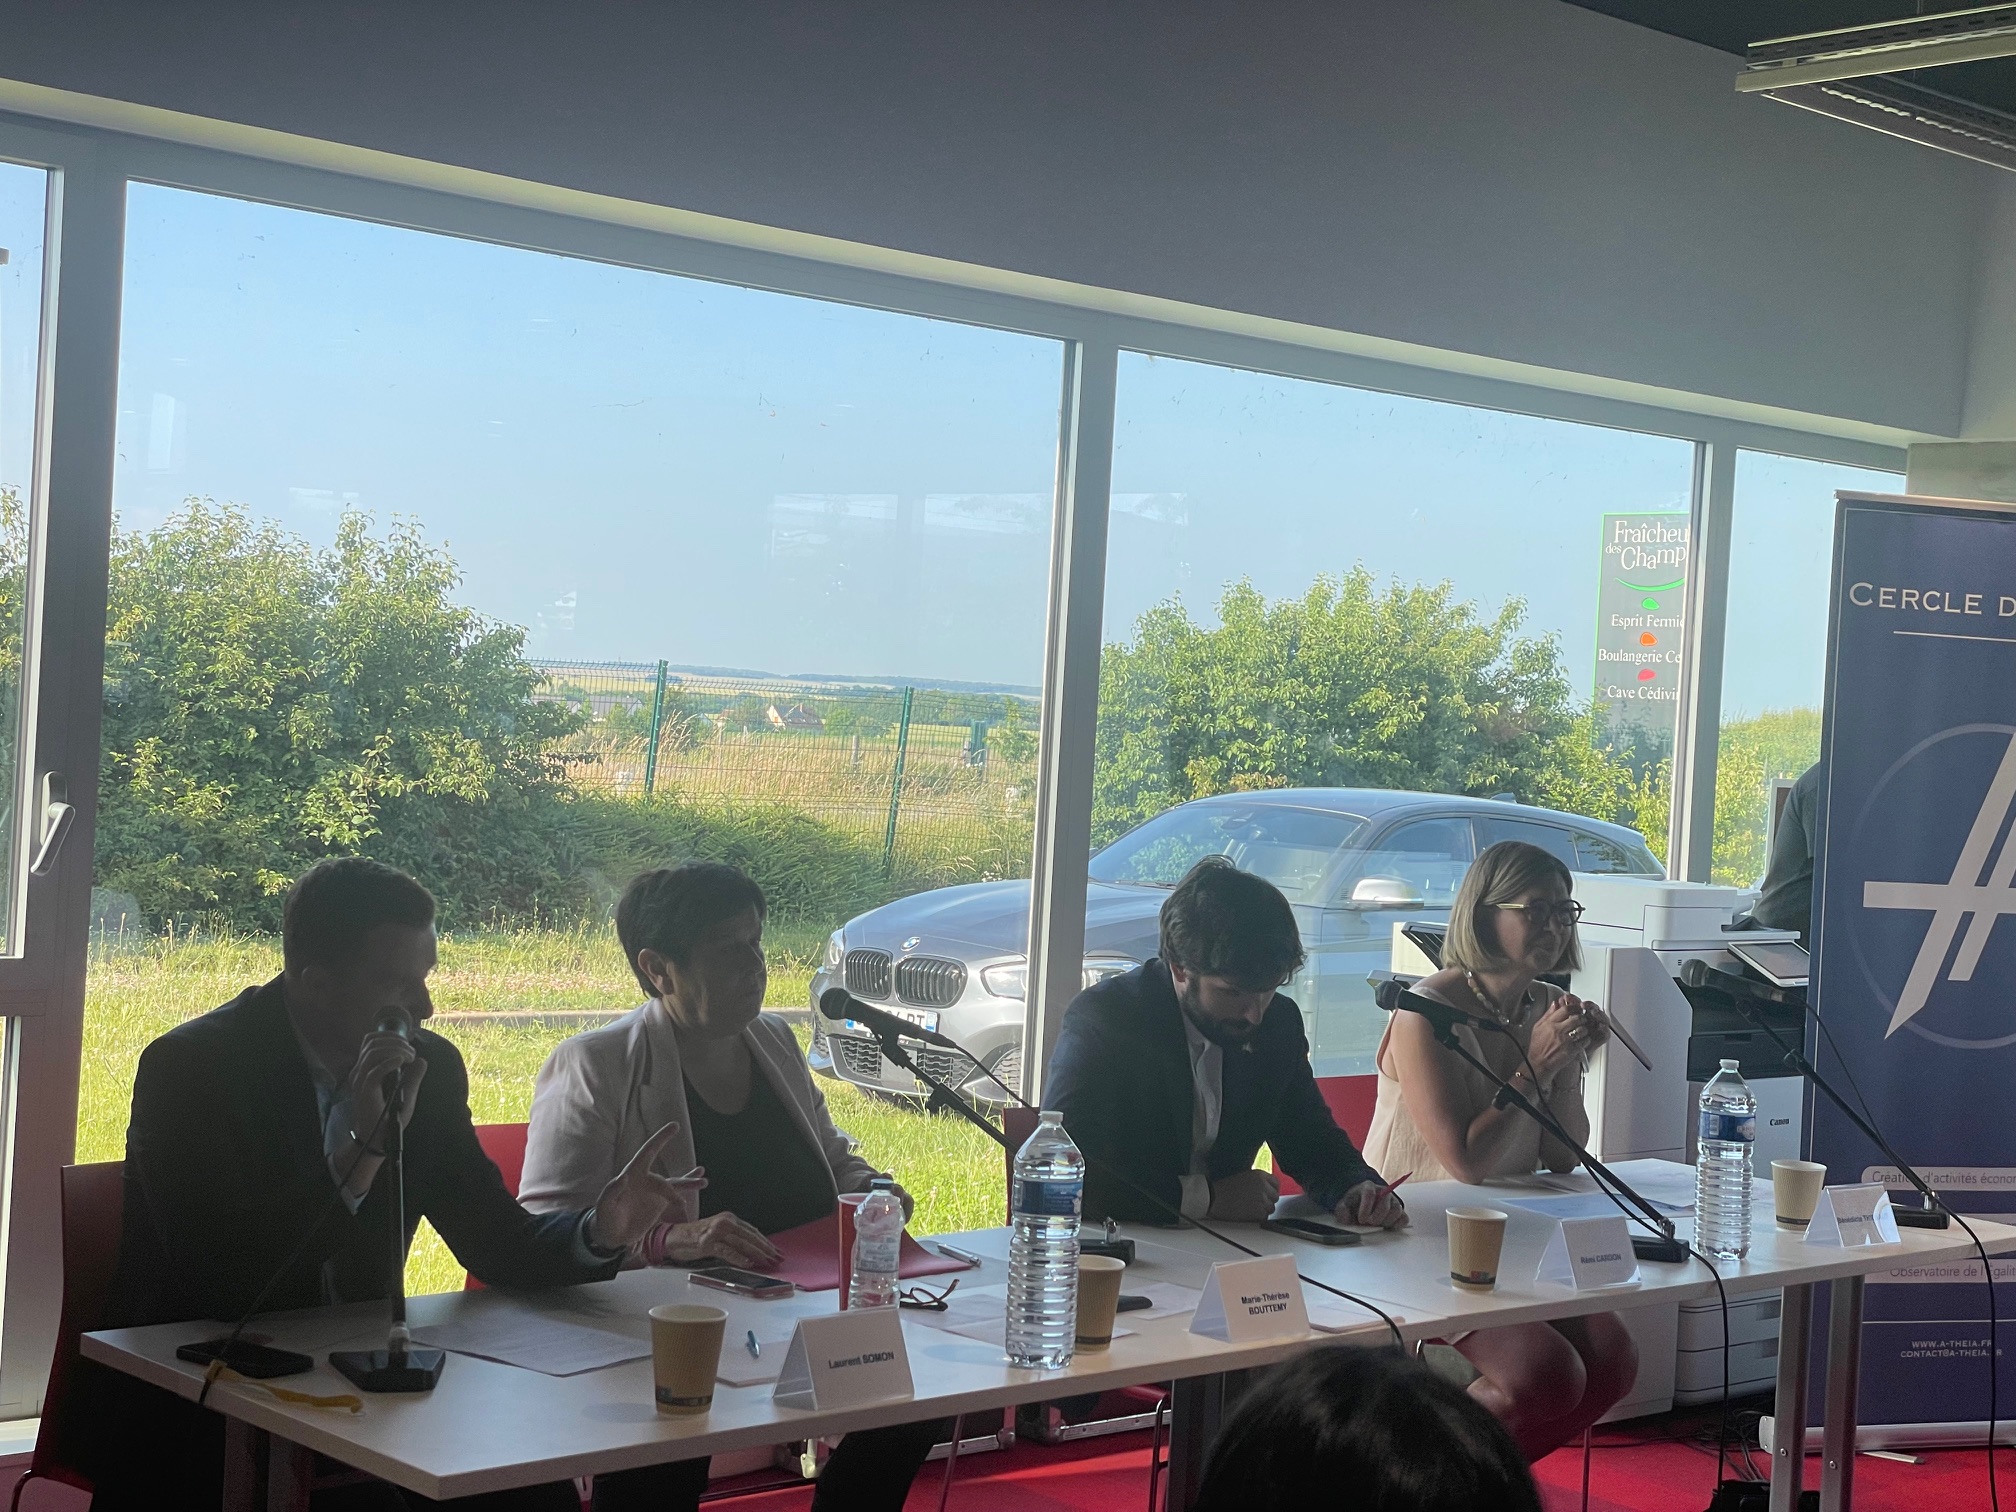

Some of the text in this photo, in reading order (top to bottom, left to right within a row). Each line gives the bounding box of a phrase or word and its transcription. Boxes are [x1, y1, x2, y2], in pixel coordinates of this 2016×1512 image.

[1605, 543, 1621, 554] des
[1849, 582, 1983, 615] CERCLE
[1611, 614, 1643, 630] Esprit
[1598, 649, 1663, 665] Boulangerie
[1607, 685, 1635, 699] Cave
[1923, 1171, 1977, 1184] d'activités
[1963, 1264, 1978, 1277] de
[1900, 1349, 2003, 1358] CONTACT@A-THEIA.R
